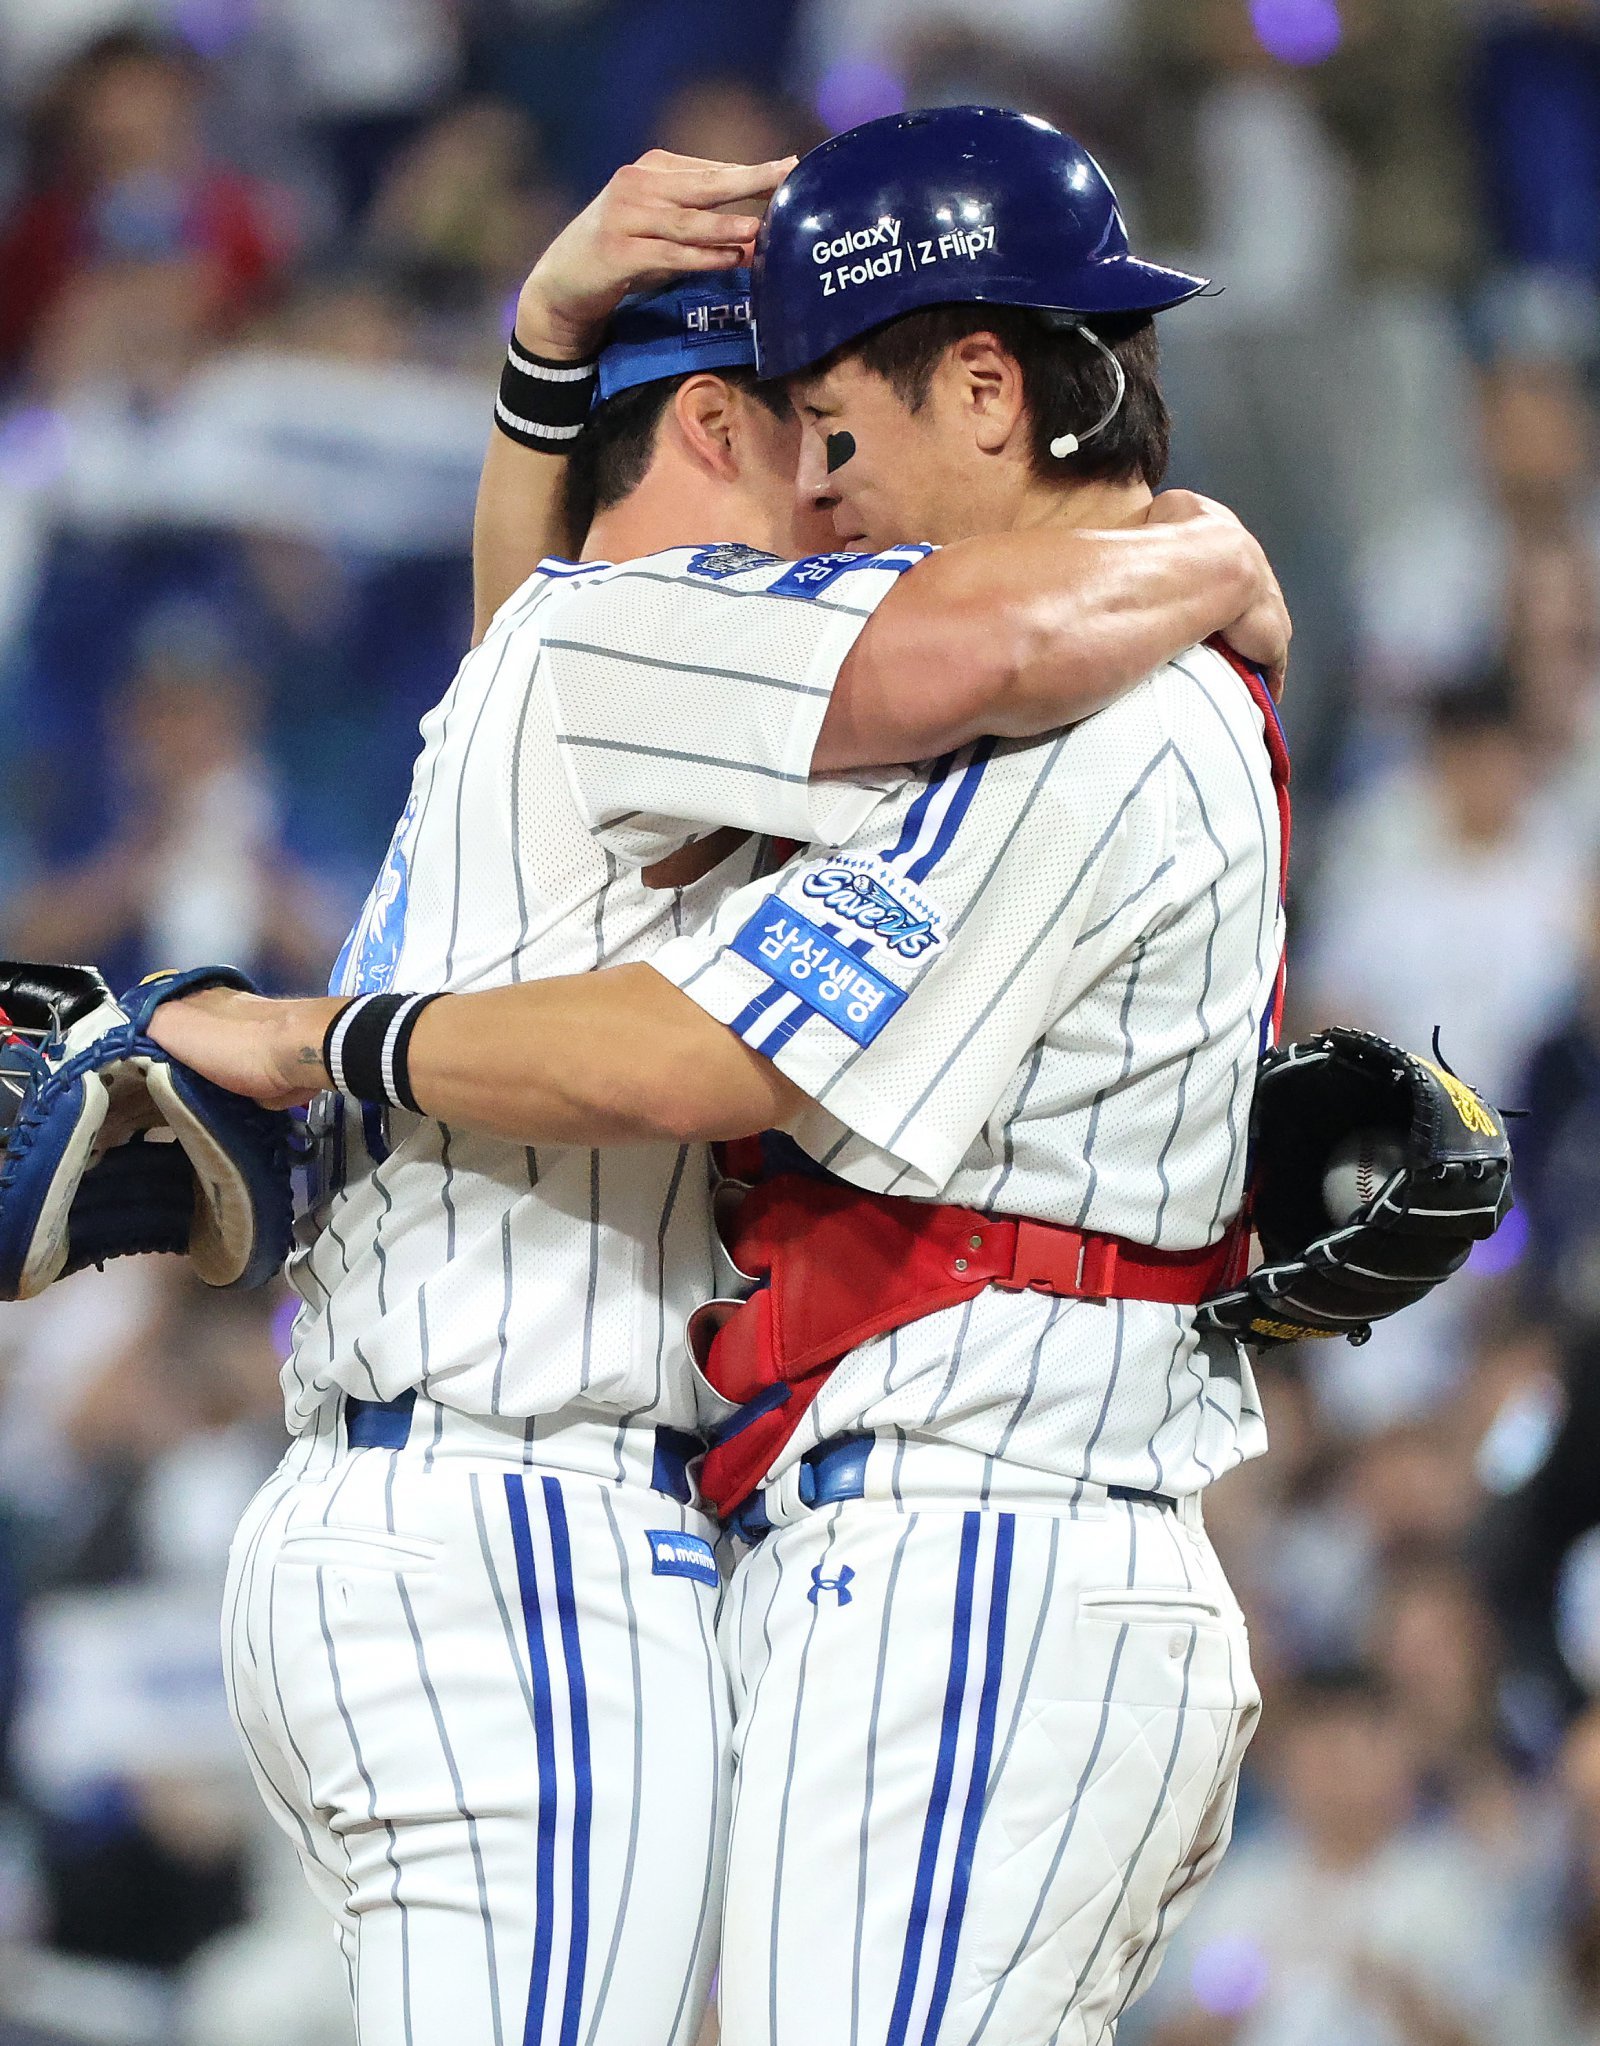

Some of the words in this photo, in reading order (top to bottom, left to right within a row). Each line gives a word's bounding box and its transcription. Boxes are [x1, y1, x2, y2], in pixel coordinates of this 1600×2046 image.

[812, 220, 901, 264] Galaxy
[819, 271, 837, 297] Z
[837, 249, 903, 290] Fold7
[917, 240, 937, 265] Z
[938, 225, 995, 260] Flip7
[793, 552, 869, 583] 삼성
[757, 918, 886, 1023] 삼성생명
